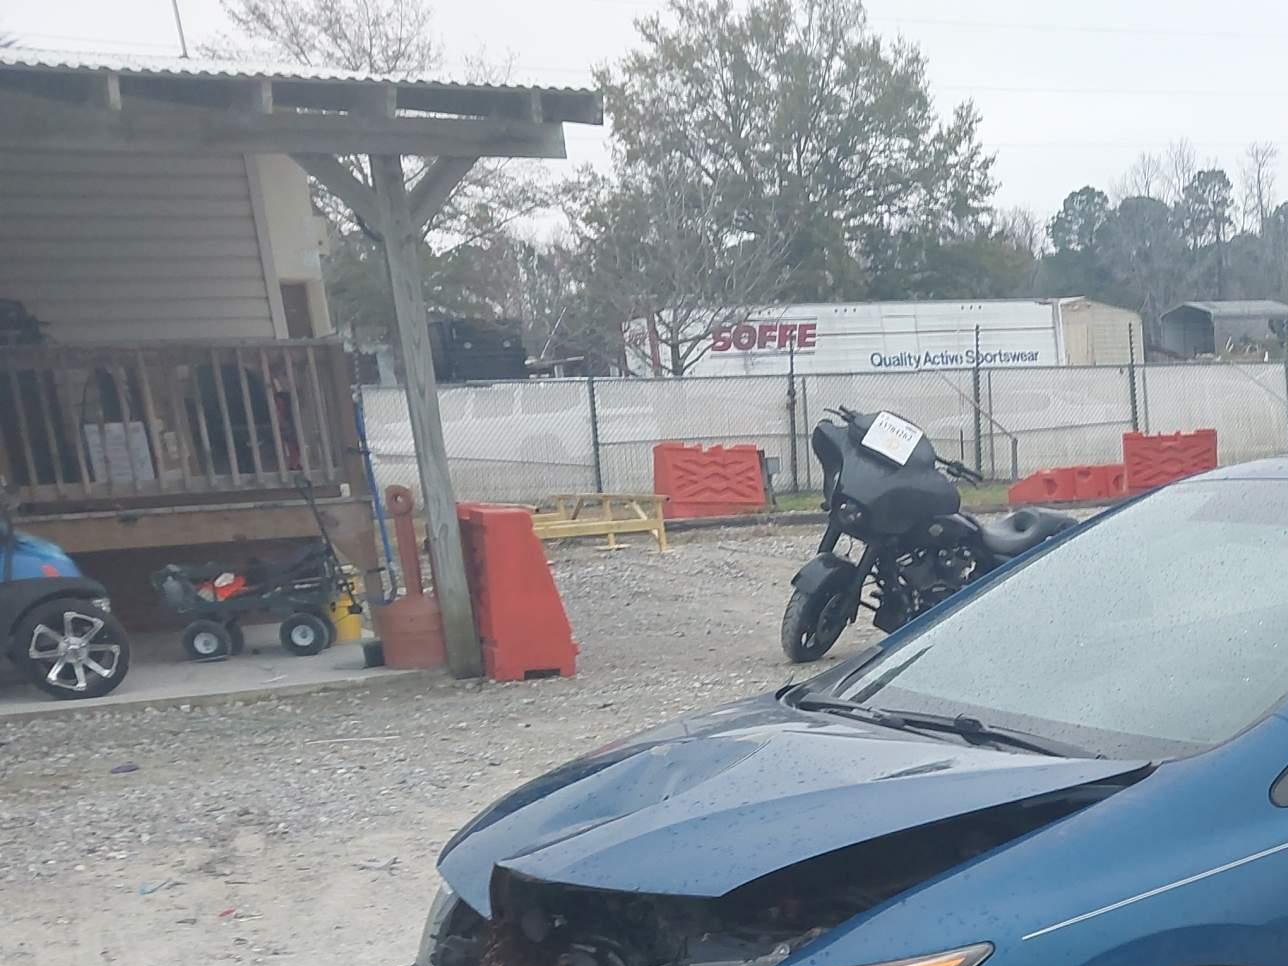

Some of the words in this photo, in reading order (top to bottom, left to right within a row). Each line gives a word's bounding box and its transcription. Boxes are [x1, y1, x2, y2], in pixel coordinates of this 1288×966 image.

[711, 323, 817, 351] SOFFE
[870, 351, 921, 368] Quality
[923, 350, 963, 365] Active
[965, 350, 1039, 367] Sportswear
